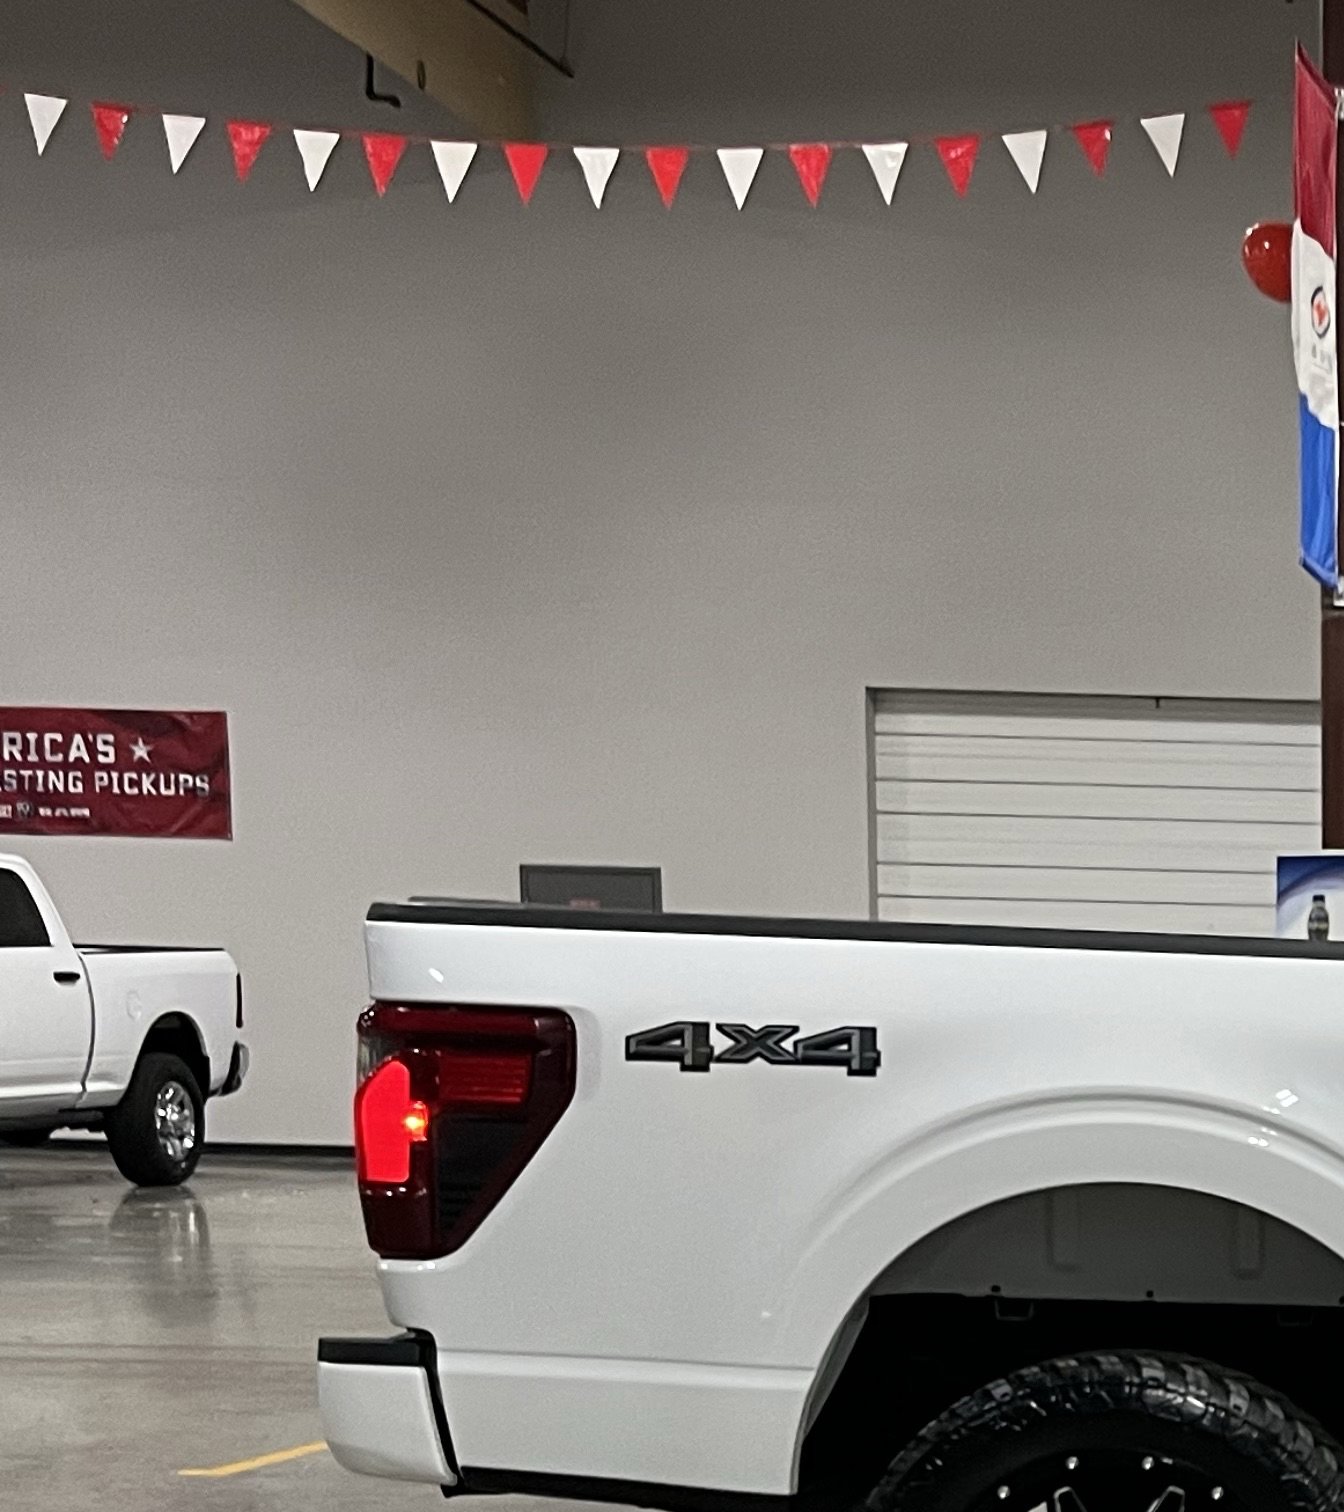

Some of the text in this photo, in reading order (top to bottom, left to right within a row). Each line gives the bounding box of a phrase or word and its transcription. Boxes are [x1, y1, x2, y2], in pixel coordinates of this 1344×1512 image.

[2, 732, 116, 764] RICA'S
[0, 769, 210, 797] STING PICKUPS
